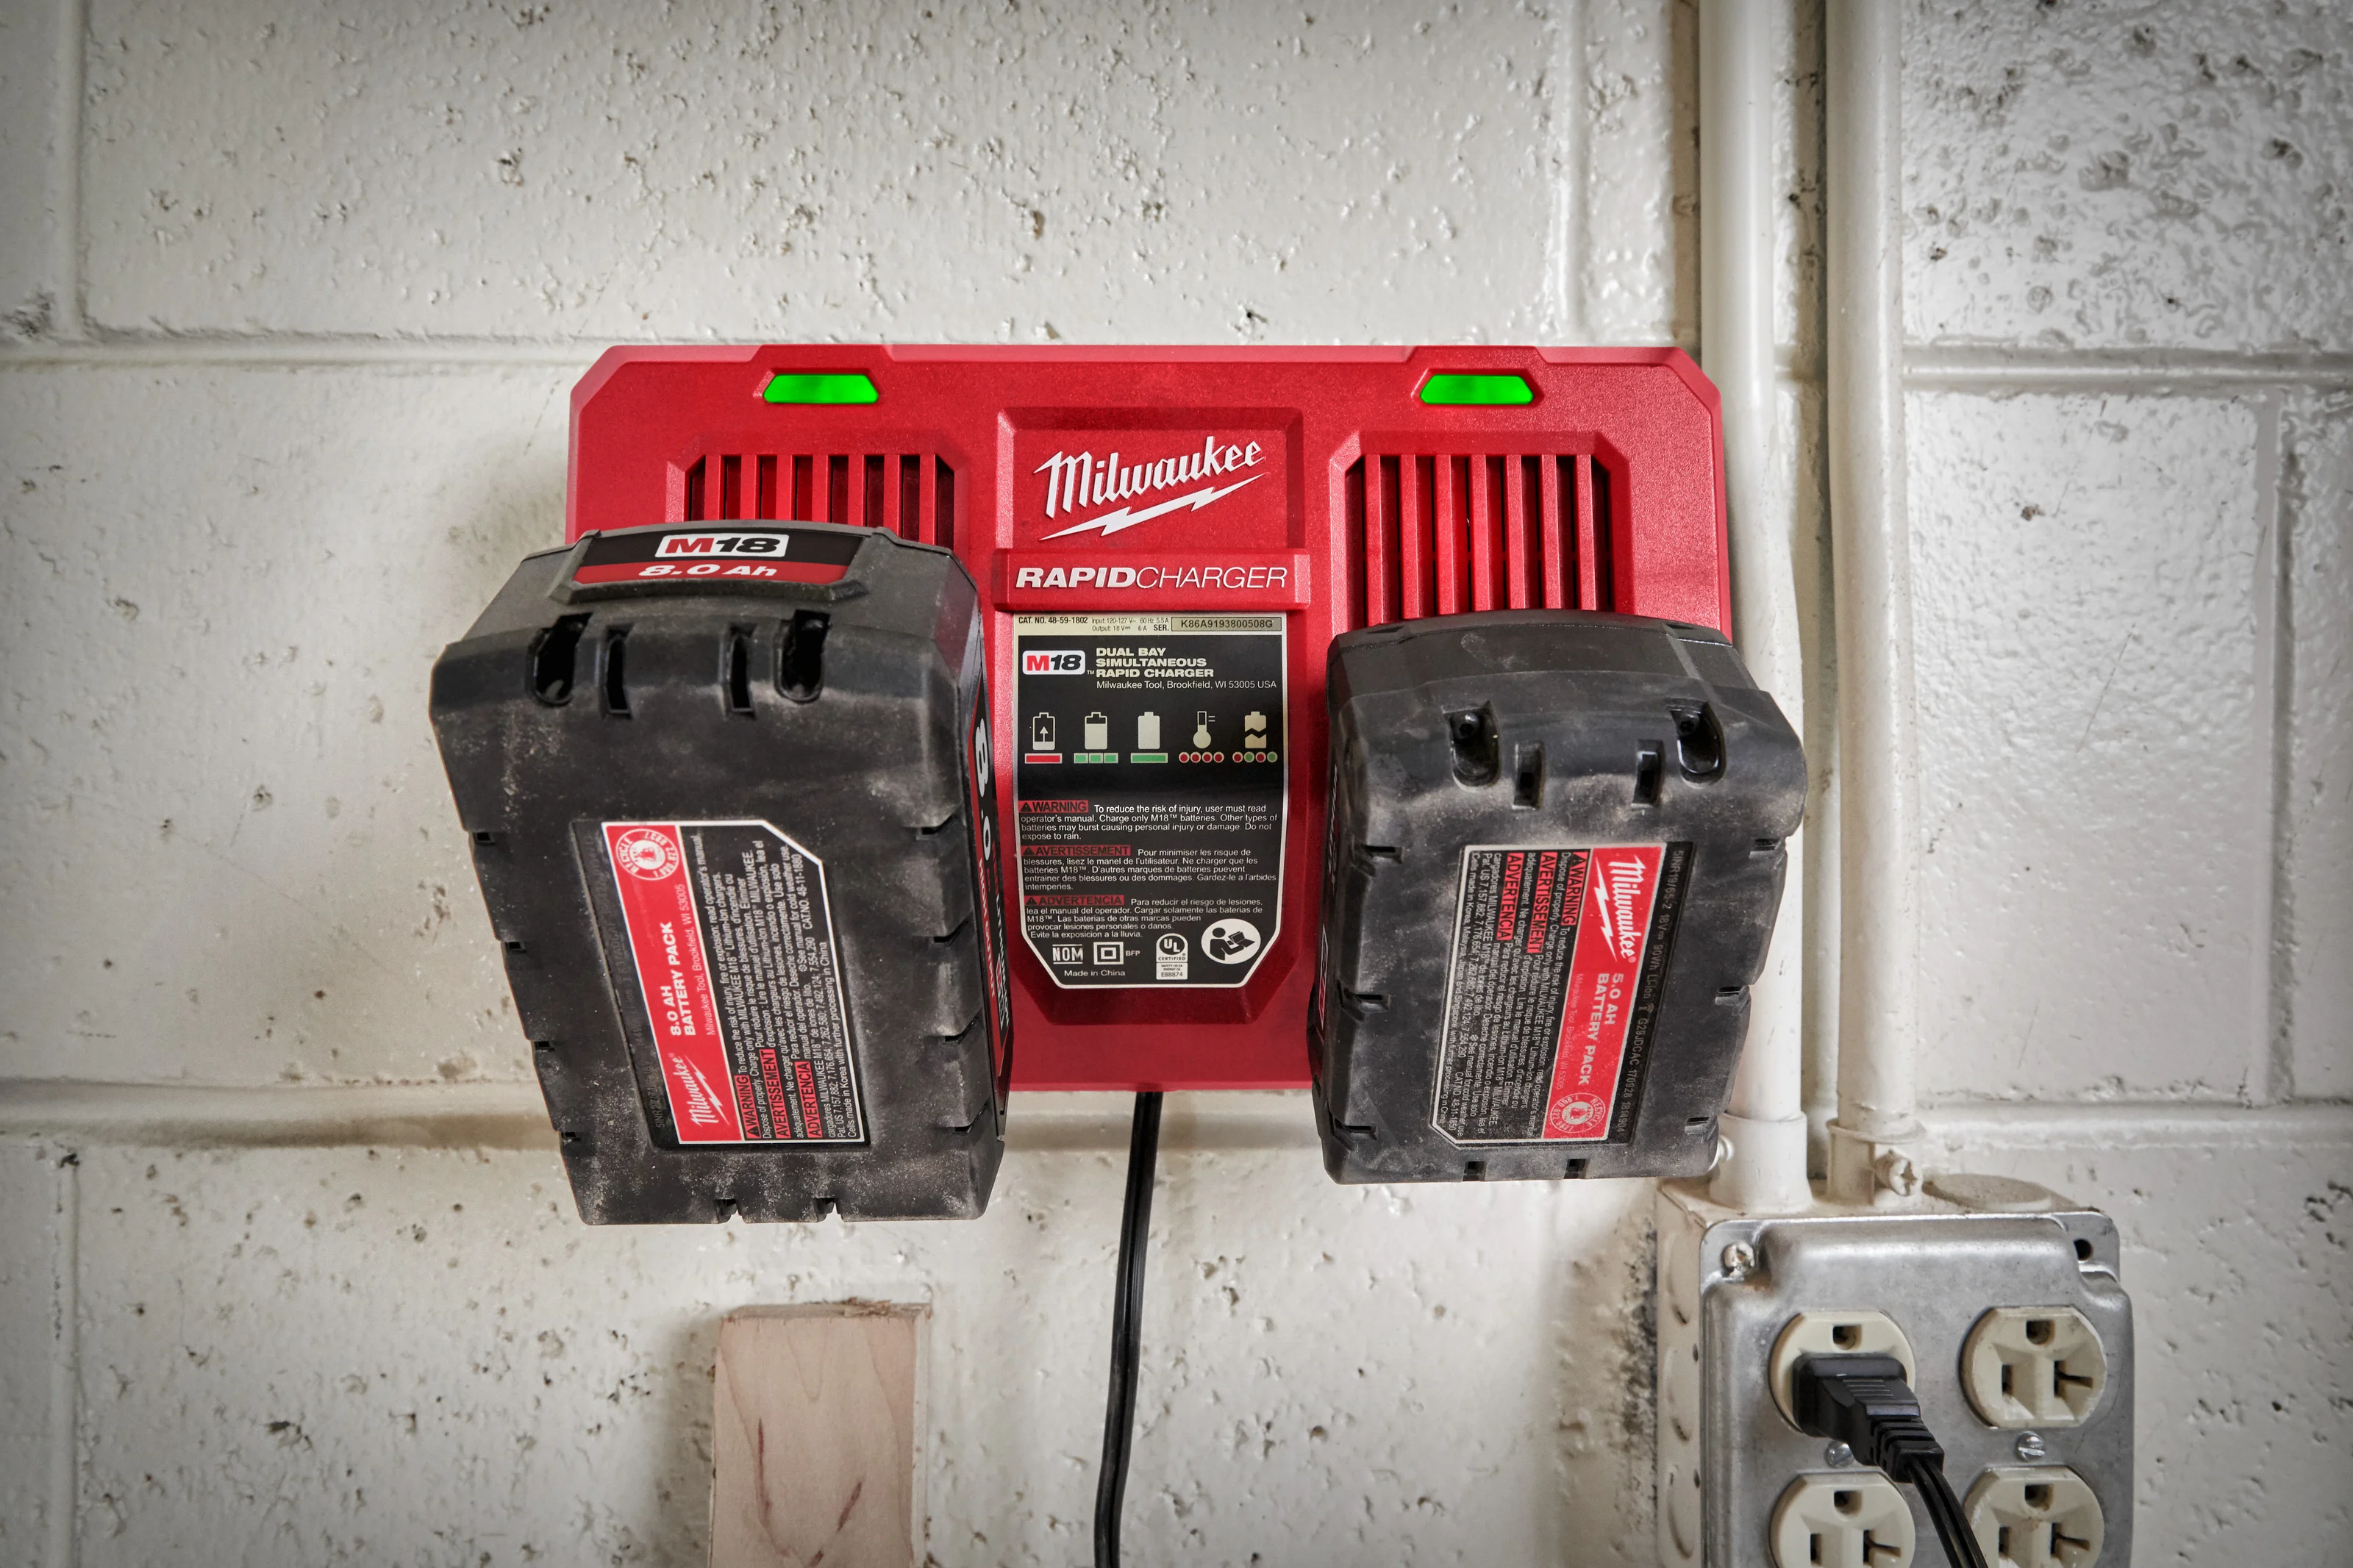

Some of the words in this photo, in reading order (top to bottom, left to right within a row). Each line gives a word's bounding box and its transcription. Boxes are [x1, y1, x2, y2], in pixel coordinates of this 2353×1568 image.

[1033, 436, 1265, 519] Milwaukee
[665, 537, 781, 554] M18
[638, 564, 721, 576] 8.0
[724, 565, 777, 577] Ah
[1181, 619, 1273, 629] K86A9193800508G
[1096, 648, 1135, 656] DUAL
[1138, 647, 1166, 656] BAY
[1026, 654, 1082, 671] M18
[1096, 658, 1207, 667] SIMULTANEOUS
[1096, 669, 1140, 678] RAPID
[1144, 668, 1214, 678] CHARGER
[1096, 681, 1143, 689] Milwaukee
[1144, 681, 1165, 690] Tool,
[1167, 681, 1213, 689] Brookfield,
[1257, 680, 1277, 688] USA
[1032, 801, 1087, 812] WARNING
[1093, 804, 1104, 813] To
[1106, 804, 1135, 813] reduce
[1137, 804, 1150, 813] the
[1151, 804, 1166, 813] risk
[1168, 804, 1177, 813] of
[1179, 804, 1203, 815] injury,
[1248, 804, 1266, 812] read
[1021, 815, 1062, 823] operator's
[1064, 815, 1096, 823] manual.
[1099, 814, 1129, 823] Charge
[1131, 814, 1149, 823] only
[1180, 814, 1217, 822] batteries.
[1246, 814, 1267, 823] types
[1101, 823, 1132, 832] causing
[1135, 823, 1170, 832] personal
[1172, 823, 1194, 832] injury
[1207, 823, 1241, 832] damage.
[1036, 846, 1128, 856] AVERTISSEMENT
[1138, 848, 1157, 856] Pour
[1087, 857, 1094, 865] le
[1096, 857, 1121, 865] manel
[1123, 857, 1134, 865] de
[1196, 857, 1227, 866] charger
[1025, 883, 1074, 891] intemperies.
[1562, 867, 1585, 924] WARNING
[1038, 896, 1123, 906] ADVERTENCIA
[1496, 853, 1522, 939] ADVERTENCIA
[1529, 854, 1556, 952] AVERTISSEMENT
[1081, 906, 1093, 914] del
[1095, 906, 1132, 915] operador.
[1134, 906, 1162, 915] Cargar
[1607, 854, 1647, 959] Milwaukee
[1061, 931, 1102, 939] exposicion
[1096, 923, 1138, 931] personales
[660, 922, 680, 965] PACK
[1053, 947, 1084, 962] NOM
[1609, 973, 1624, 999] 5.0
[660, 986, 676, 1007] AH
[671, 970, 696, 1036] BATTERY
[1587, 973, 1610, 1041] BATTERY
[1604, 1003, 1618, 1025] AH
[666, 1011, 682, 1036] 8.0
[1578, 1045, 1596, 1085] PACK
[673, 1056, 719, 1128] Milwaukee
[760, 1050, 790, 1137] AVERTISSEMENT
[796, 1062, 821, 1136] ADVERTENCIA
[736, 1076, 757, 1126] WARNING
